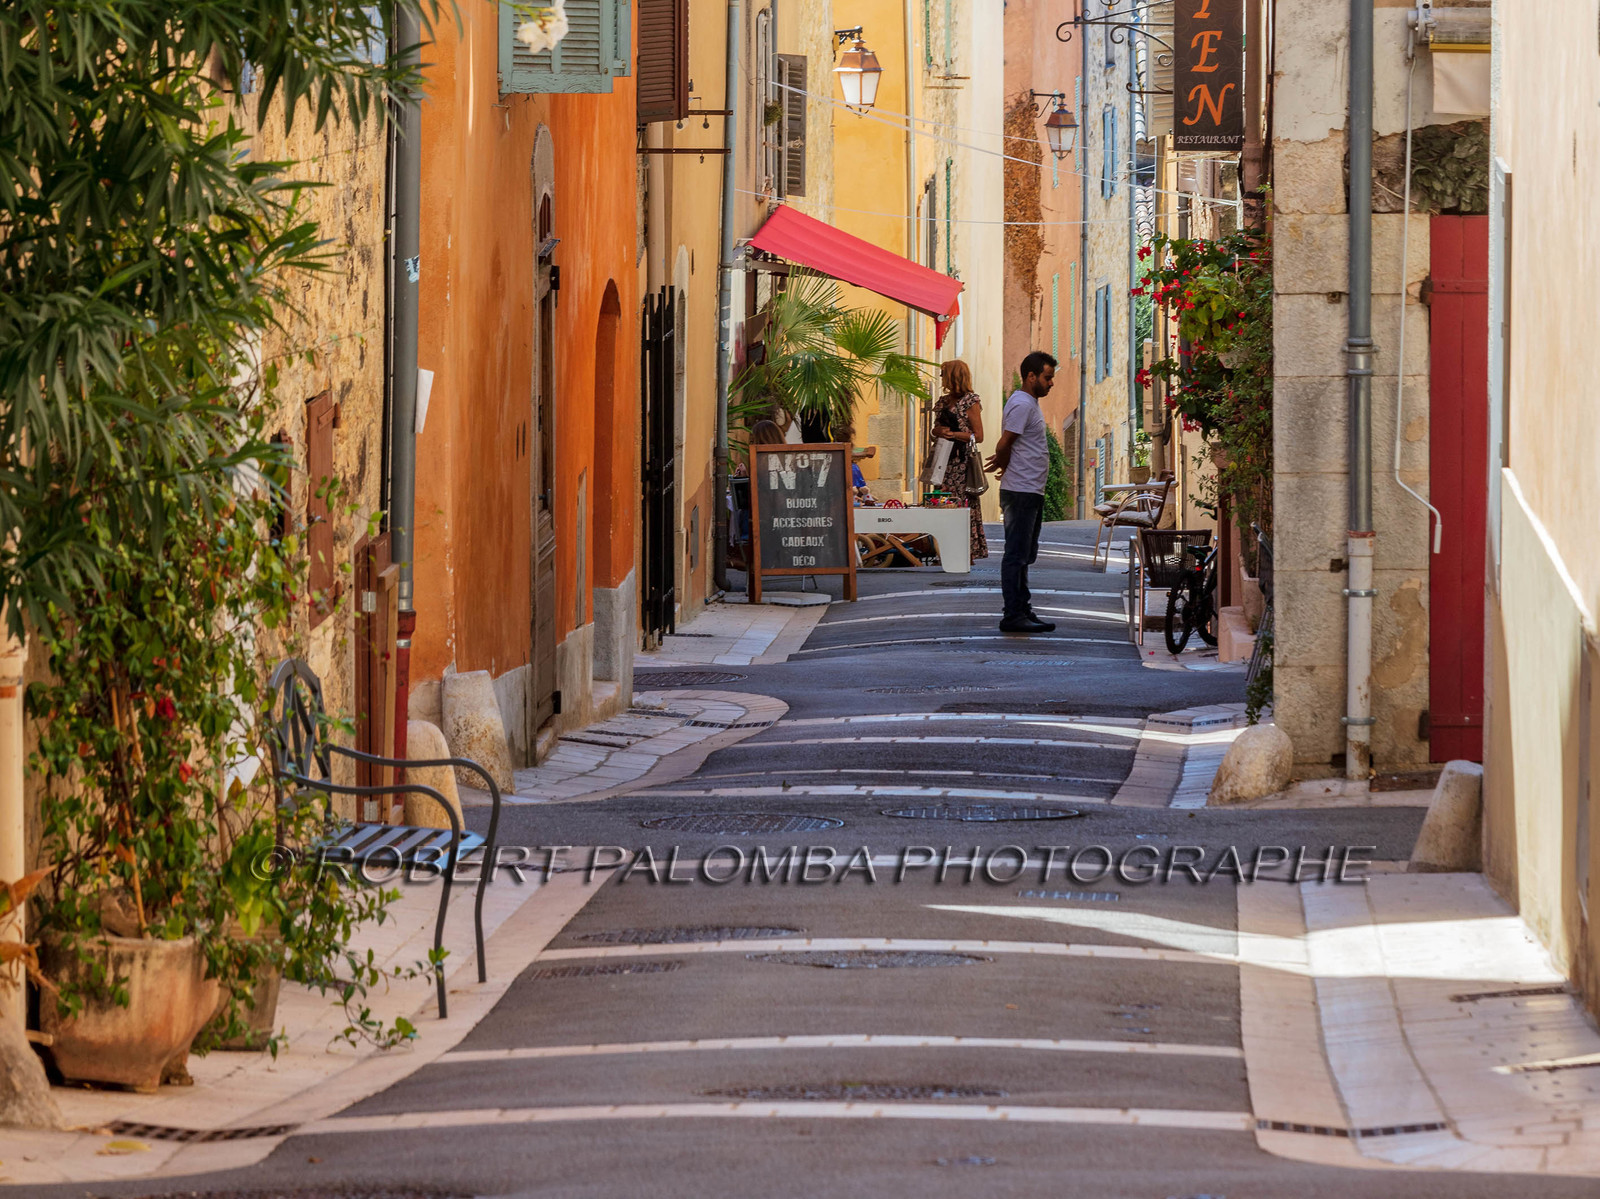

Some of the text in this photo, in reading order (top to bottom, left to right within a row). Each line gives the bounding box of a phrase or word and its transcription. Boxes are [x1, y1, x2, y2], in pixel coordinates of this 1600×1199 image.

[1177, 135, 1241, 144] RESTAURANT
[786, 498, 817, 508] BIJOUX
[773, 517, 833, 528] ACCESSOIRES
[781, 536, 825, 547] CADEAUX
[792, 555, 816, 566] DÉCO
